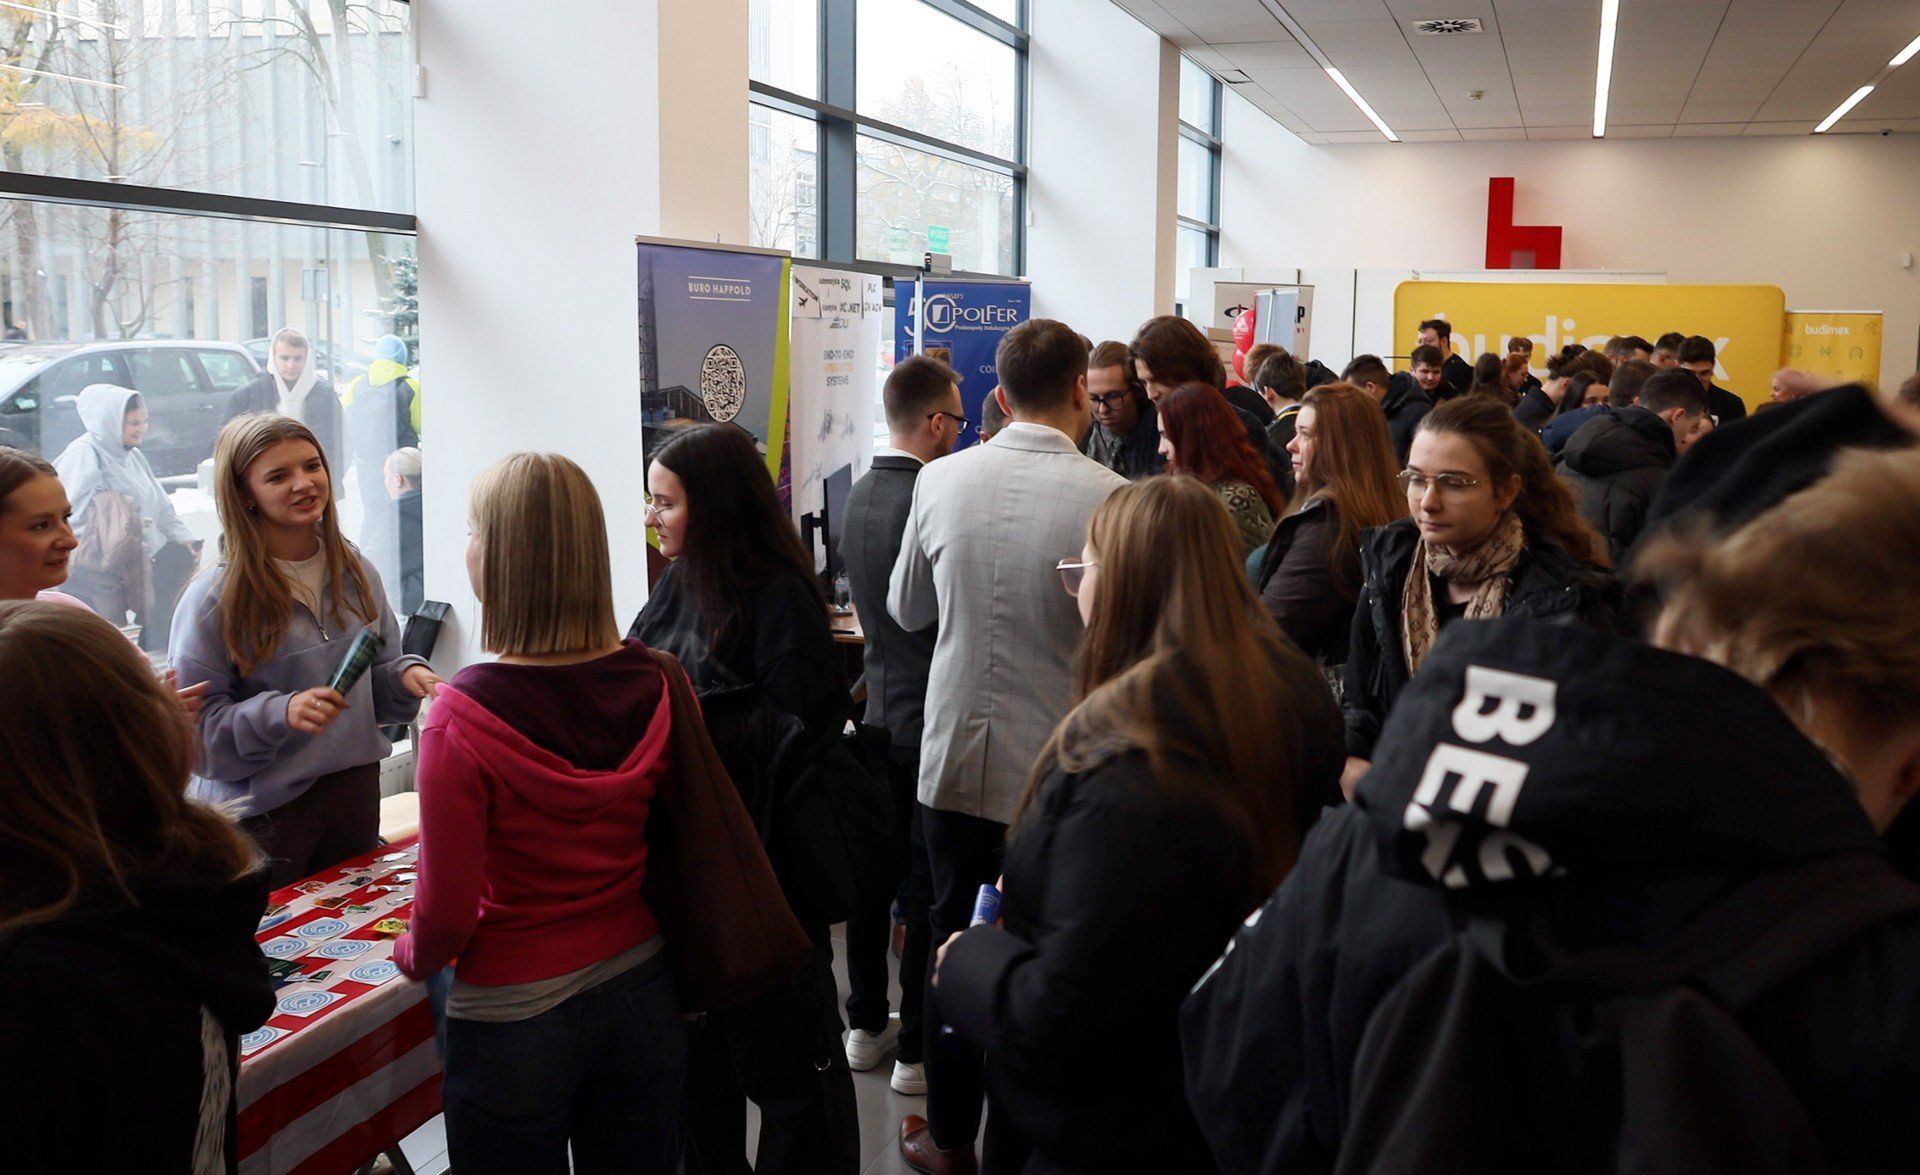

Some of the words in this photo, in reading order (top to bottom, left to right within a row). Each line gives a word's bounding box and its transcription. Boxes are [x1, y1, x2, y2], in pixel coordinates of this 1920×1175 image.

[688, 282, 711, 293] BURO
[713, 284, 751, 296] HAPPOLD
[952, 305, 1018, 325] POLFER
[1804, 323, 1850, 336] budimex
[826, 375, 849, 387] SYSTEMS
